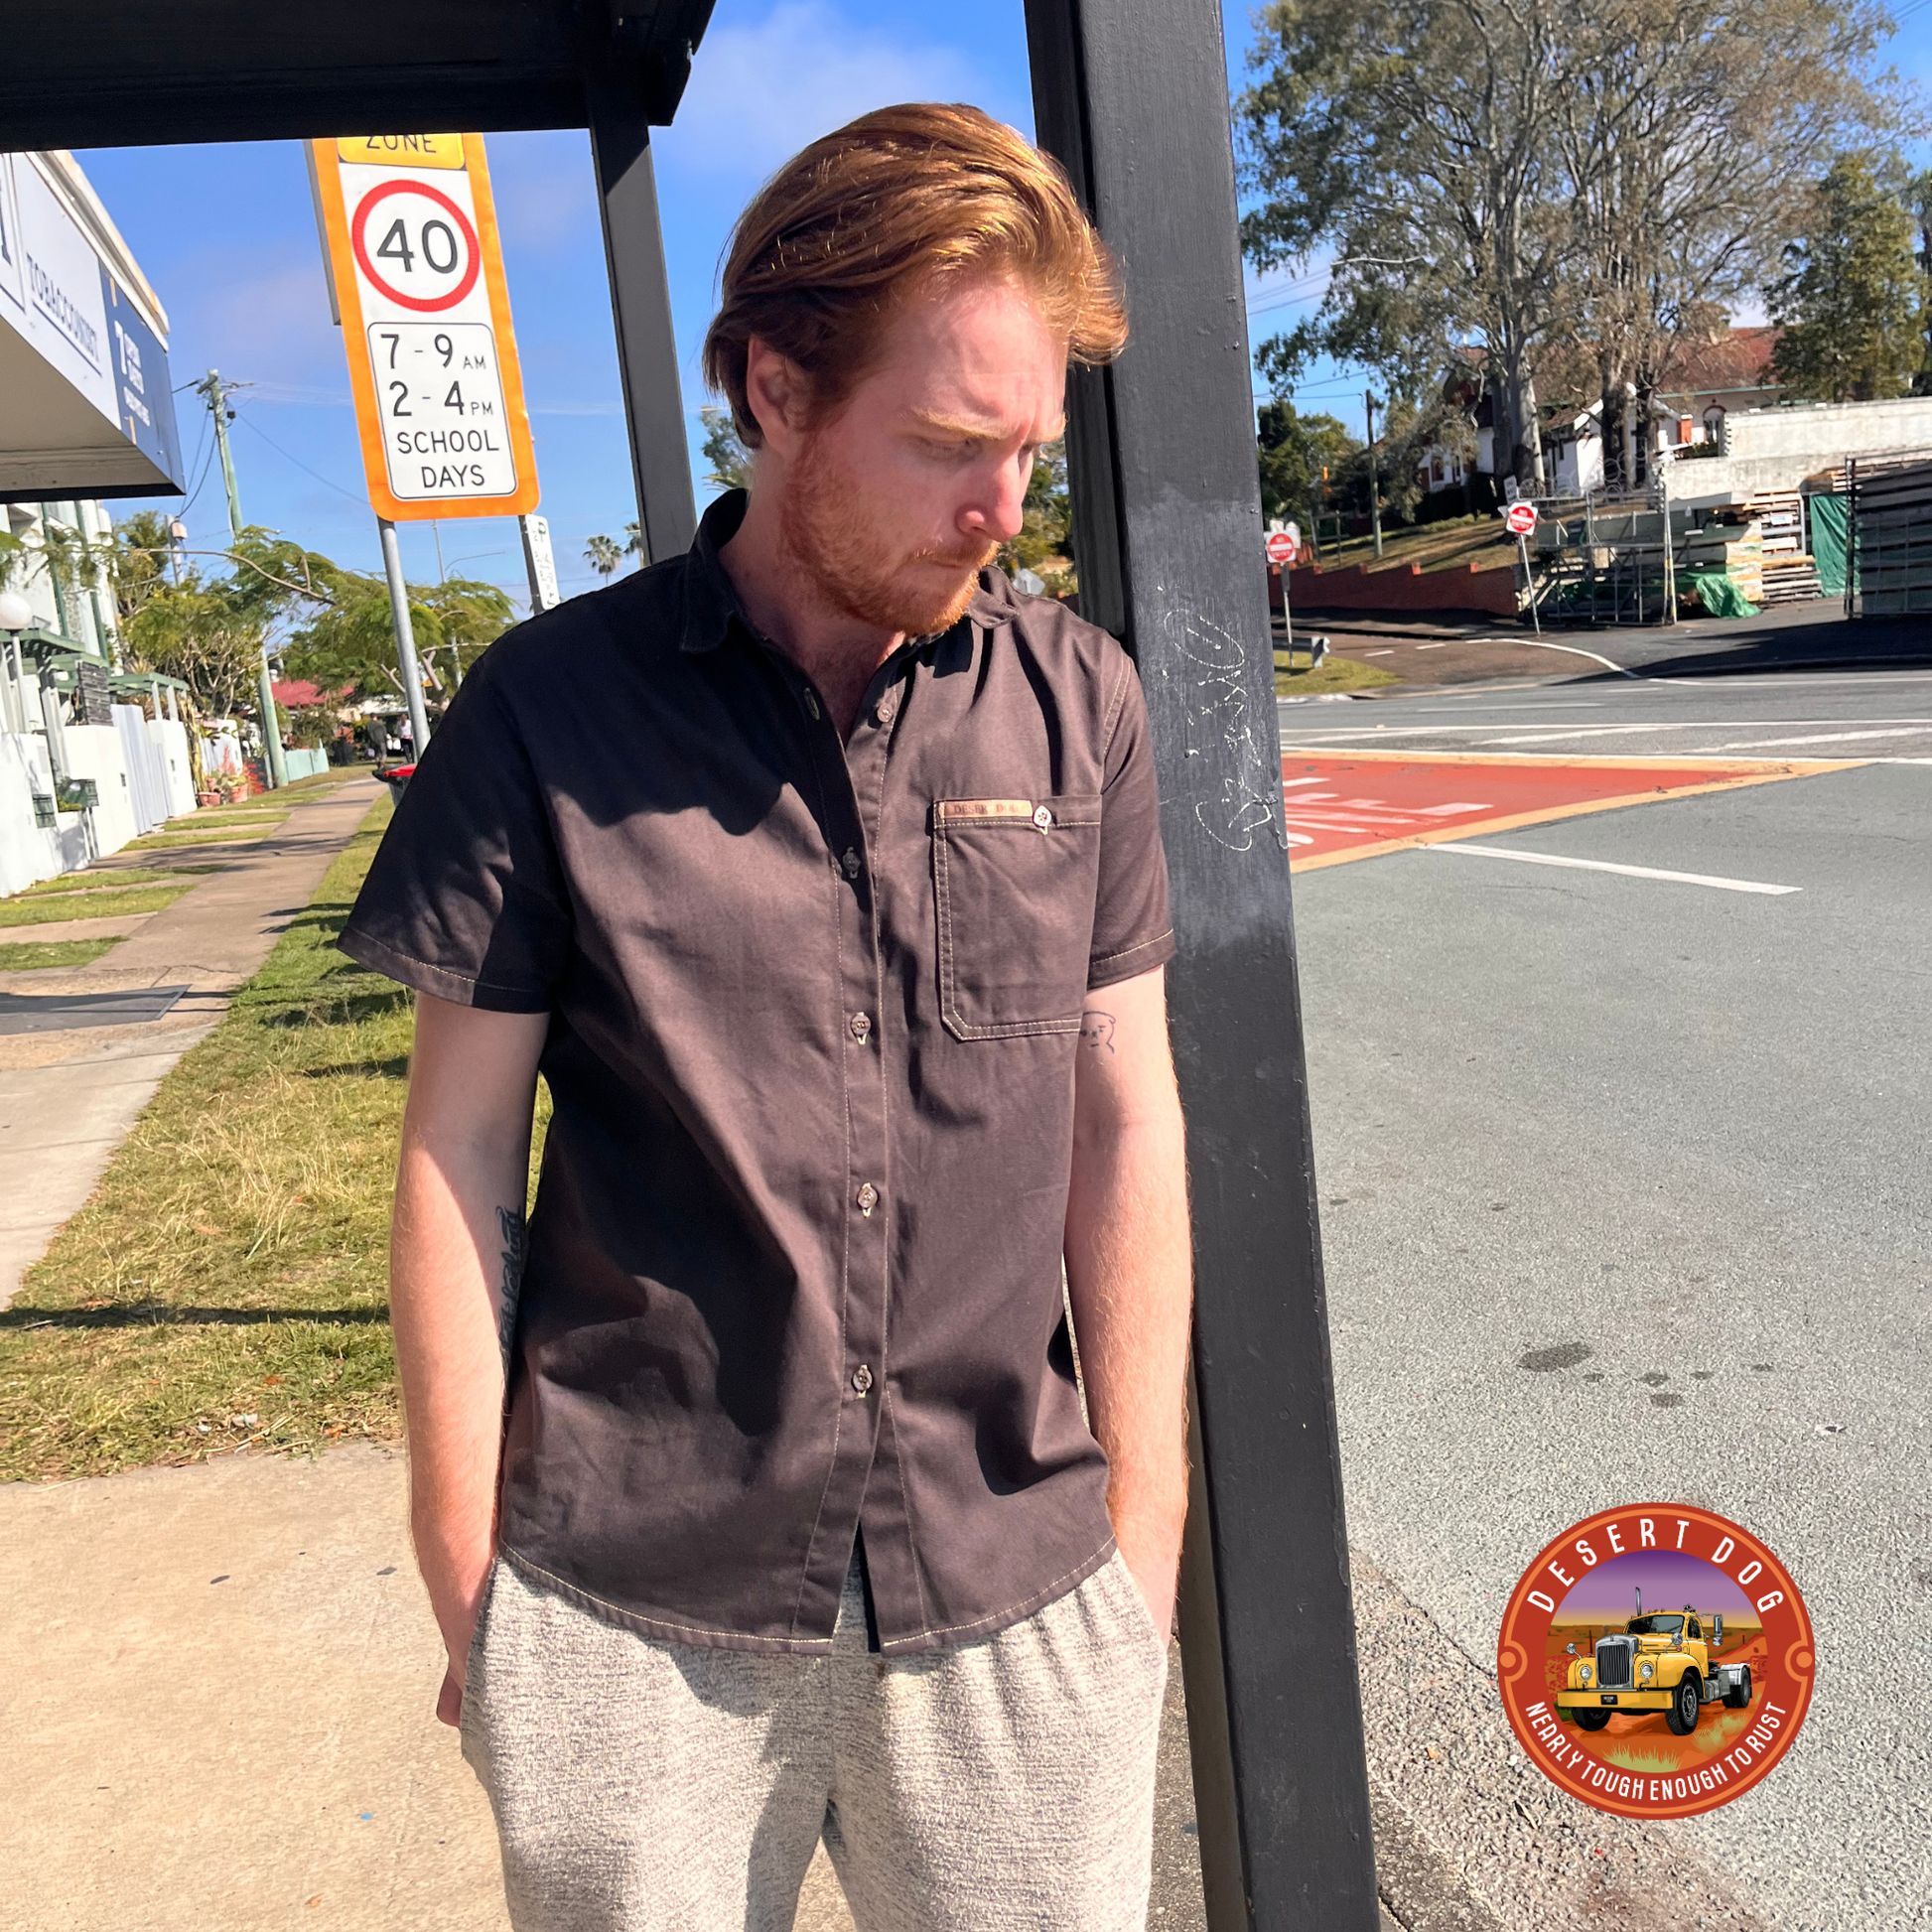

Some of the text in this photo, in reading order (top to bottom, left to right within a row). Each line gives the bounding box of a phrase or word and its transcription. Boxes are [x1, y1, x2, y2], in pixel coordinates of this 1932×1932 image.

[365, 134, 437, 154] ZONE
[376, 218, 458, 274] 40
[463, 355, 486, 370] AM
[471, 401, 493, 416] PM
[397, 430, 499, 454] SCHOOL
[421, 465, 485, 488] DAYS
